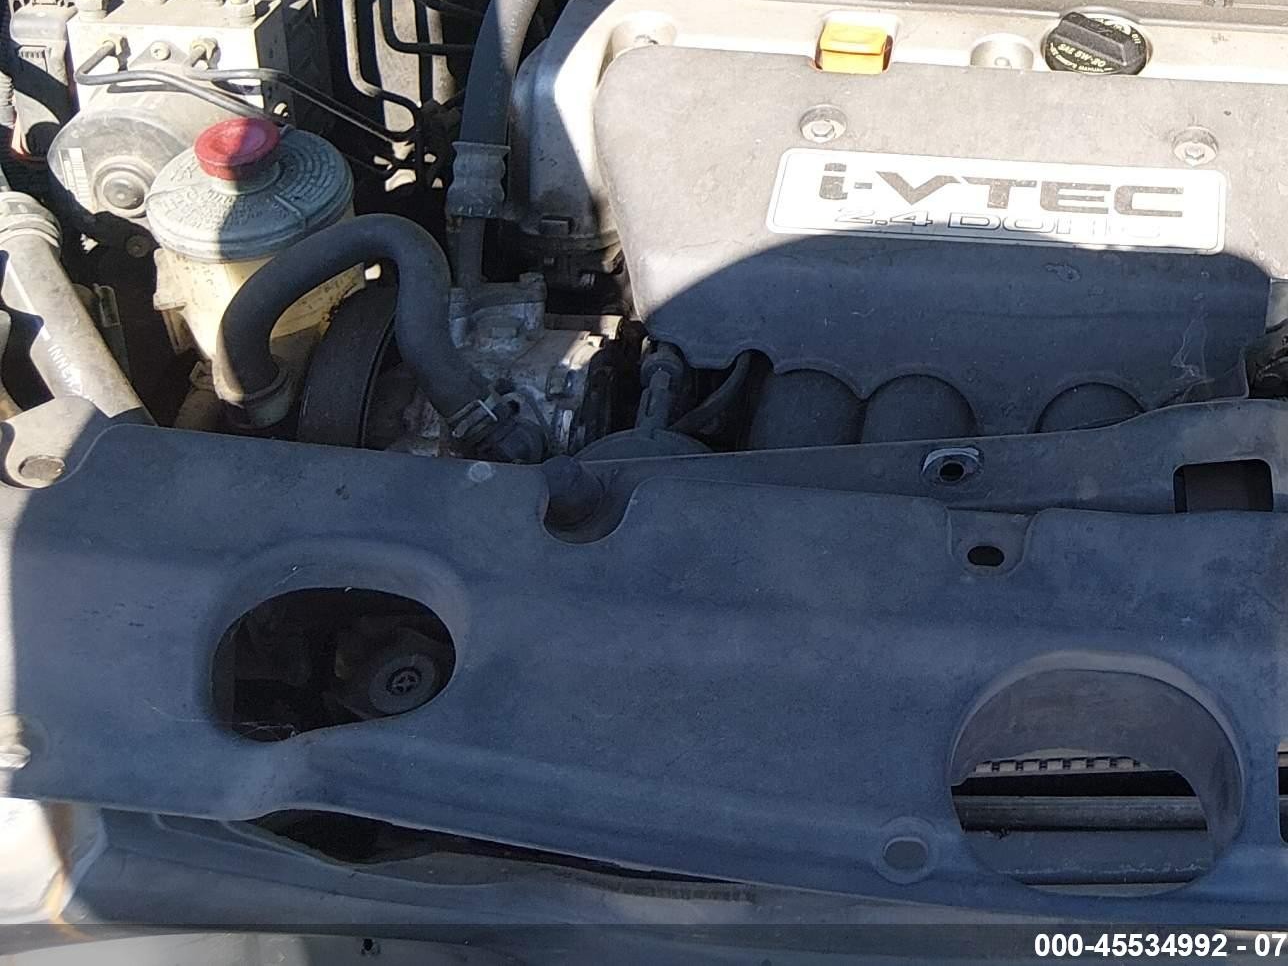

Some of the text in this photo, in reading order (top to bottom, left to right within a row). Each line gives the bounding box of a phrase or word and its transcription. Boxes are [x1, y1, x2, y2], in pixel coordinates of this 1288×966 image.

[1057, 42, 1107, 68] SAE 5W-20
[818, 161, 1185, 218] i-VTEC
[834, 207, 1162, 240] 2.4 DOHC
